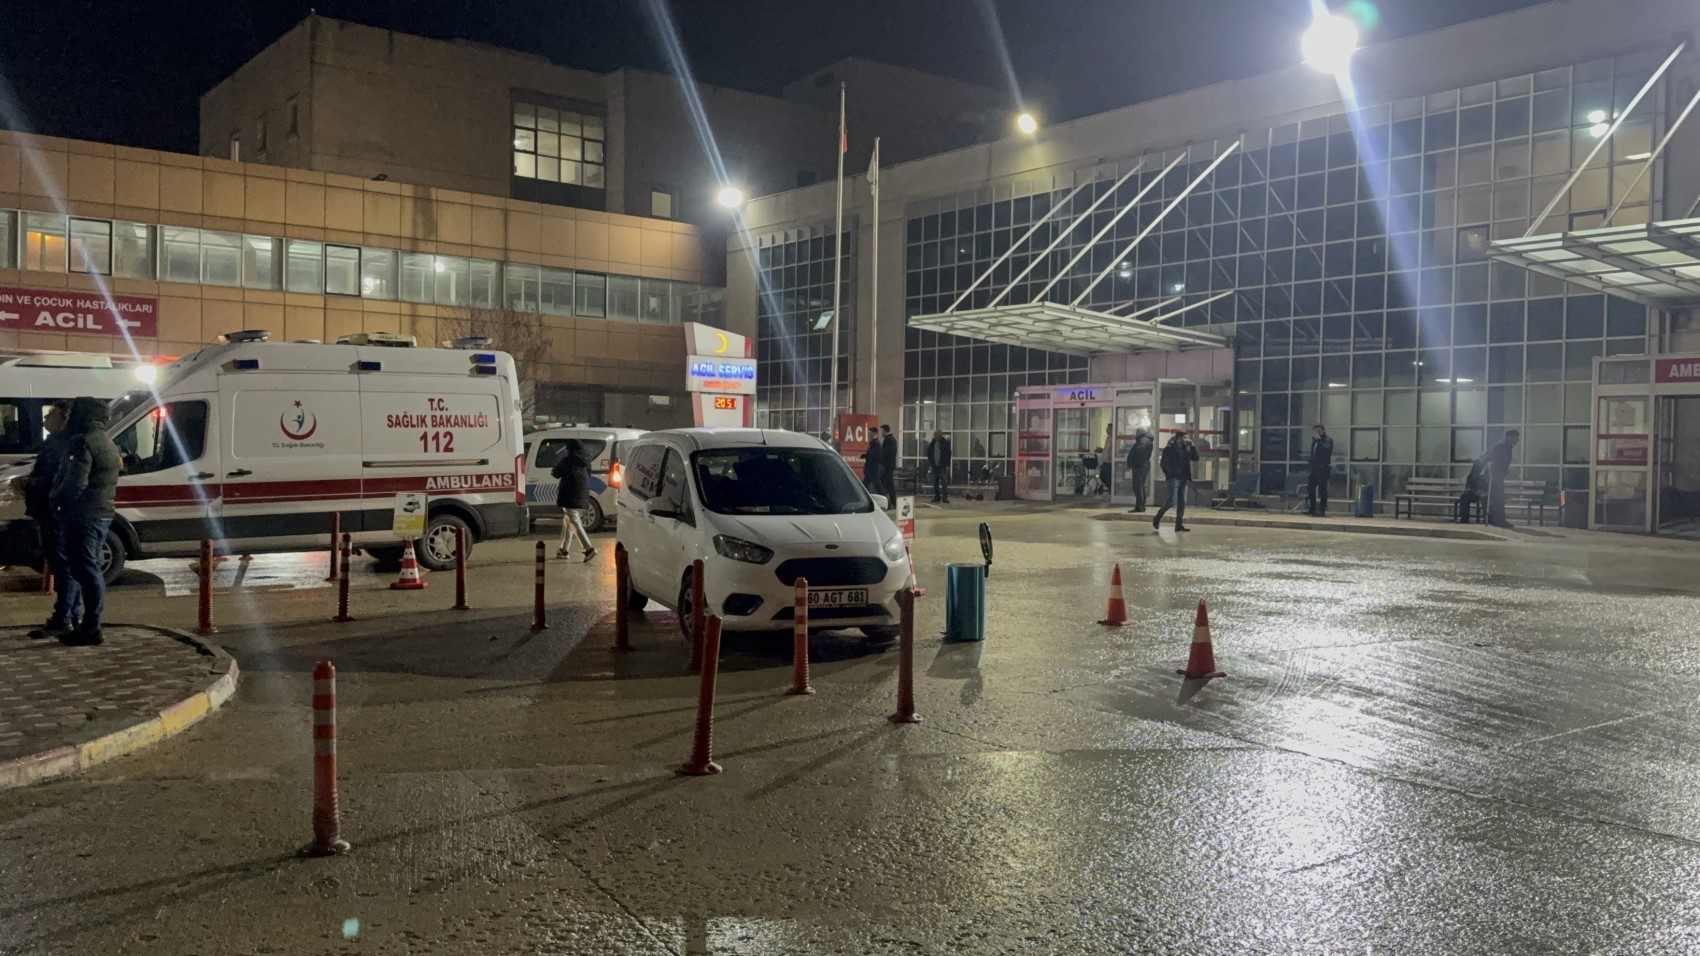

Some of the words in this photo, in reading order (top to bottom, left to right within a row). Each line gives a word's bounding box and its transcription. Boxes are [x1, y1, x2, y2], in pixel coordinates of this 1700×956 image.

[16, 295, 31, 305] VE
[33, 296, 73, 308] ÇOCUK
[76, 299, 153, 314] HASTALIKLARI
[691, 361, 716, 377] ACİL
[719, 363, 754, 379] SERVİS
[1668, 363, 1700, 378] AMB
[1069, 389, 1096, 401] ACİL
[427, 398, 449, 412] T.C.
[386, 411, 428, 429] SAĞLIK
[431, 411, 488, 429] BAKANLIĞI
[844, 422, 869, 443] ACİ
[419, 431, 454, 453] 112
[425, 473, 513, 490] AMBULANS
[807, 592, 820, 604] 60
[823, 592, 844, 604] AGT
[847, 591, 865, 603] 681
